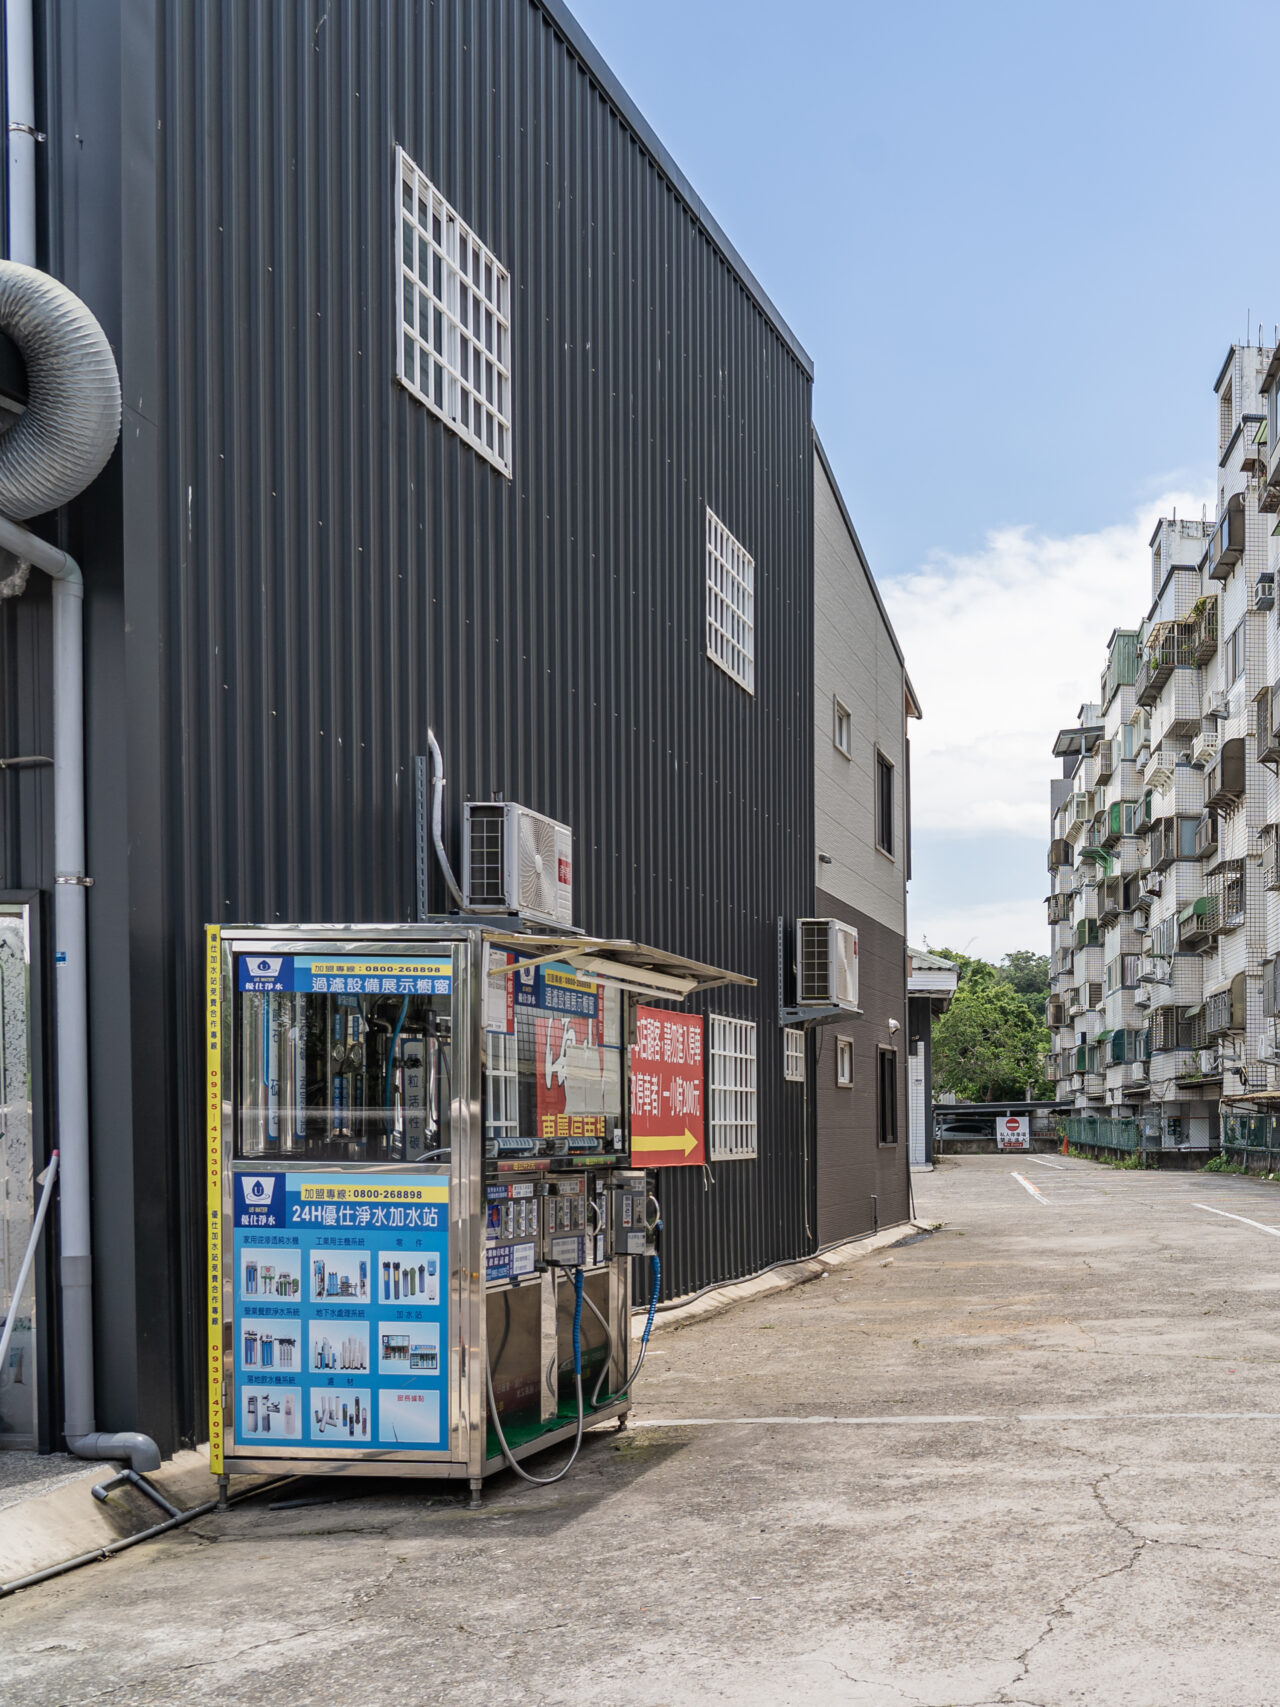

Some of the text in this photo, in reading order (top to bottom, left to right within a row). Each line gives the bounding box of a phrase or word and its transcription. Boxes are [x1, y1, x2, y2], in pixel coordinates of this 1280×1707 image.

[312, 977, 450, 994] 過濾設備展示櫥窗
